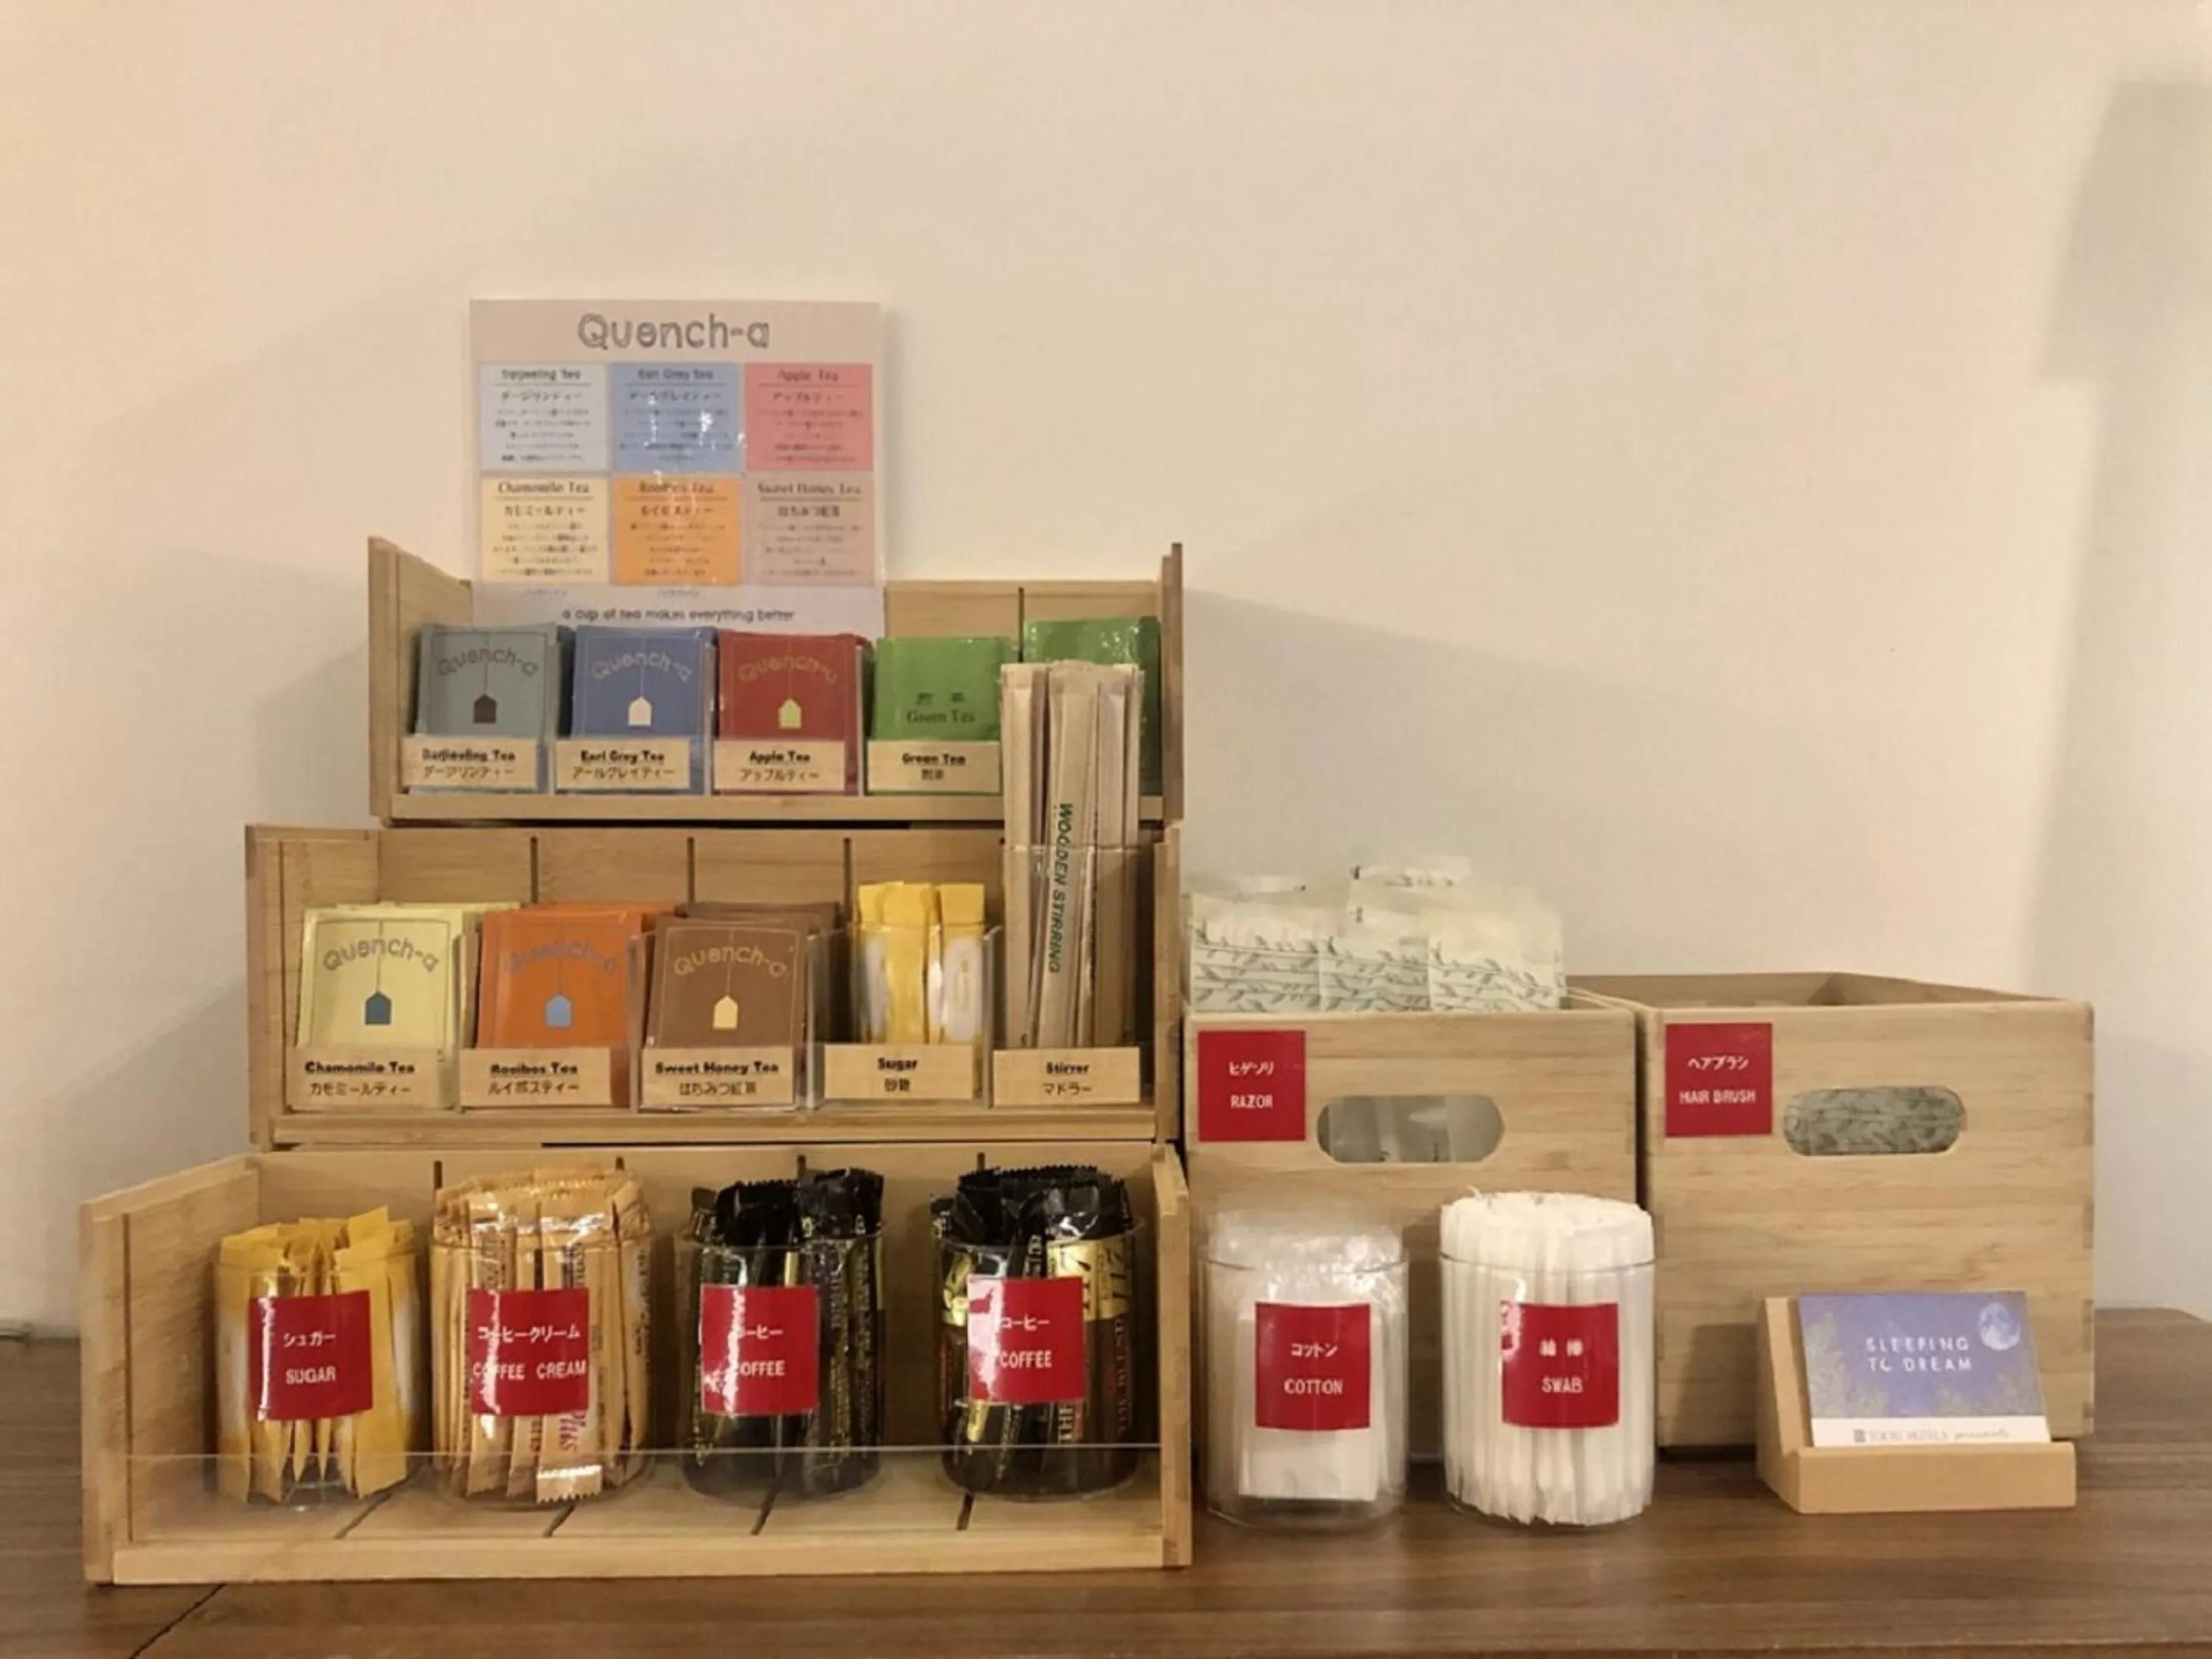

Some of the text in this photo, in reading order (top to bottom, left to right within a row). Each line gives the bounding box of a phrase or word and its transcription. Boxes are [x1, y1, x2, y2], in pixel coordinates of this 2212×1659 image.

[578, 313, 770, 350] Quench-a
[576, 610, 599, 623] cup
[603, 608, 617, 620] of
[619, 608, 641, 620] tea
[688, 608, 754, 624] everything
[757, 608, 796, 621] better
[492, 748, 515, 762] Tea
[581, 750, 665, 764] Earl Grey Tea
[749, 750, 811, 765] Apple Tea
[901, 752, 967, 766] Green Tea
[1048, 803, 1073, 974] WOODEN STIRRING
[323, 935, 439, 973] Quench-a
[674, 944, 788, 978] Quench-a
[304, 1061, 416, 1074] Chamomile Tea
[489, 1061, 578, 1075] Rooibos Tea
[655, 1061, 780, 1076] Sweet Honey Tea
[877, 1056, 919, 1072] Sugar
[1045, 1061, 1091, 1075] Stirrer
[1229, 1061, 1275, 1076] ヒゲソリ
[1687, 1055, 1750, 1071] ヘアブラシ
[310, 1081, 412, 1097] カモミールティー
[488, 1079, 580, 1094] ルイボスティー
[1041, 1081, 1092, 1097] マドラー
[1230, 1094, 1274, 1110] RAZOR
[1679, 1088, 1757, 1104] HAIR BRUSH
[1000, 1313, 1051, 1332] コーヒー
[283, 1331, 337, 1347] シュガー
[1865, 1336, 1970, 1353] SLEEPING
[1290, 1342, 1339, 1358] コットン
[1000, 1349, 1053, 1369] COFFEE
[1902, 1356, 1973, 1373] DREAM
[285, 1366, 337, 1386] SUGAR
[472, 1359, 587, 1381] CFEE CREAM
[732, 1359, 786, 1378] OFFEE
[1283, 1377, 1344, 1396] COTTON
[1541, 1375, 1584, 1394] SWAB
